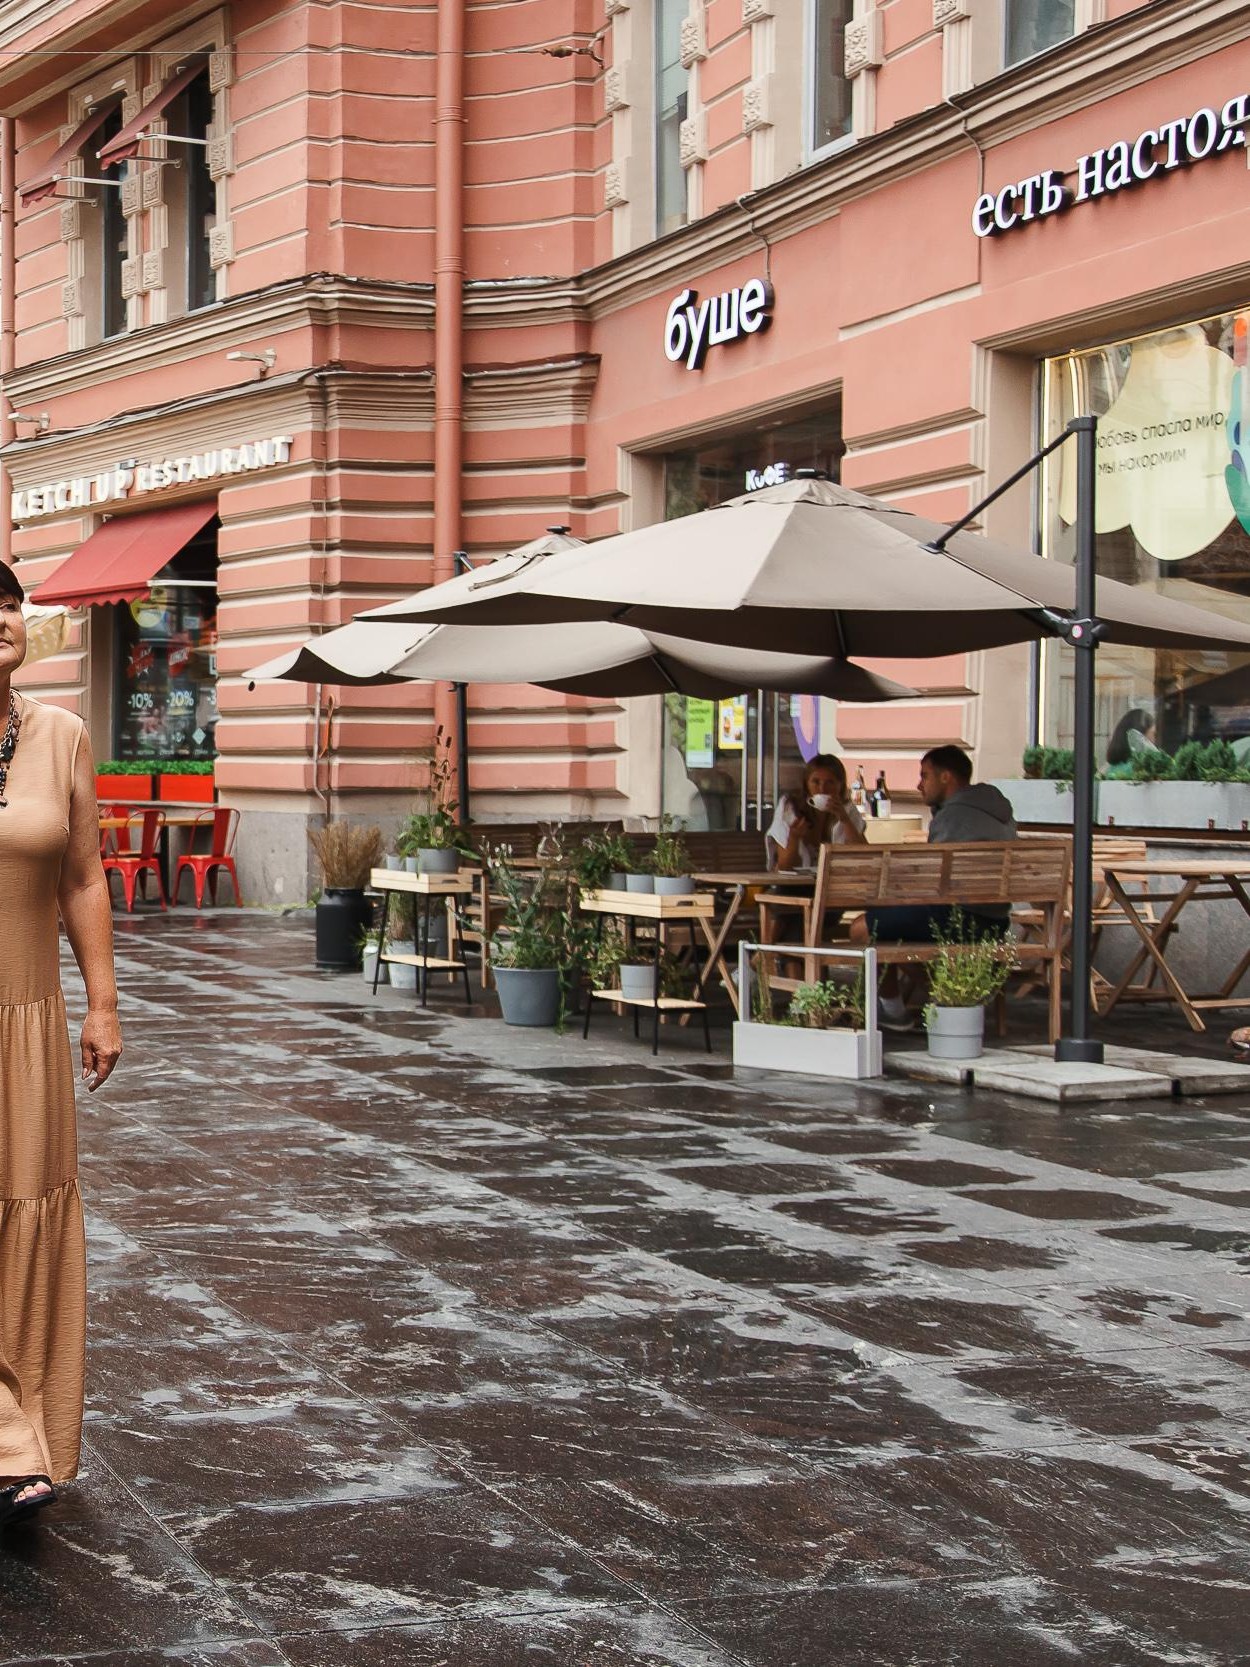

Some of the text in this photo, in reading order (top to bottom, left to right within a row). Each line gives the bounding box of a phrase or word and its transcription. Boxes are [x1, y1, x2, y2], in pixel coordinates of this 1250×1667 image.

[971, 169, 1063, 238] есть
[664, 278, 768, 371] буше
[1141, 418, 1192, 441] спасла
[11, 435, 294, 520] KETCH UP RESTAURANT
[1118, 448, 1187, 473] накормим
[166, 690, 195, 707] -20%
